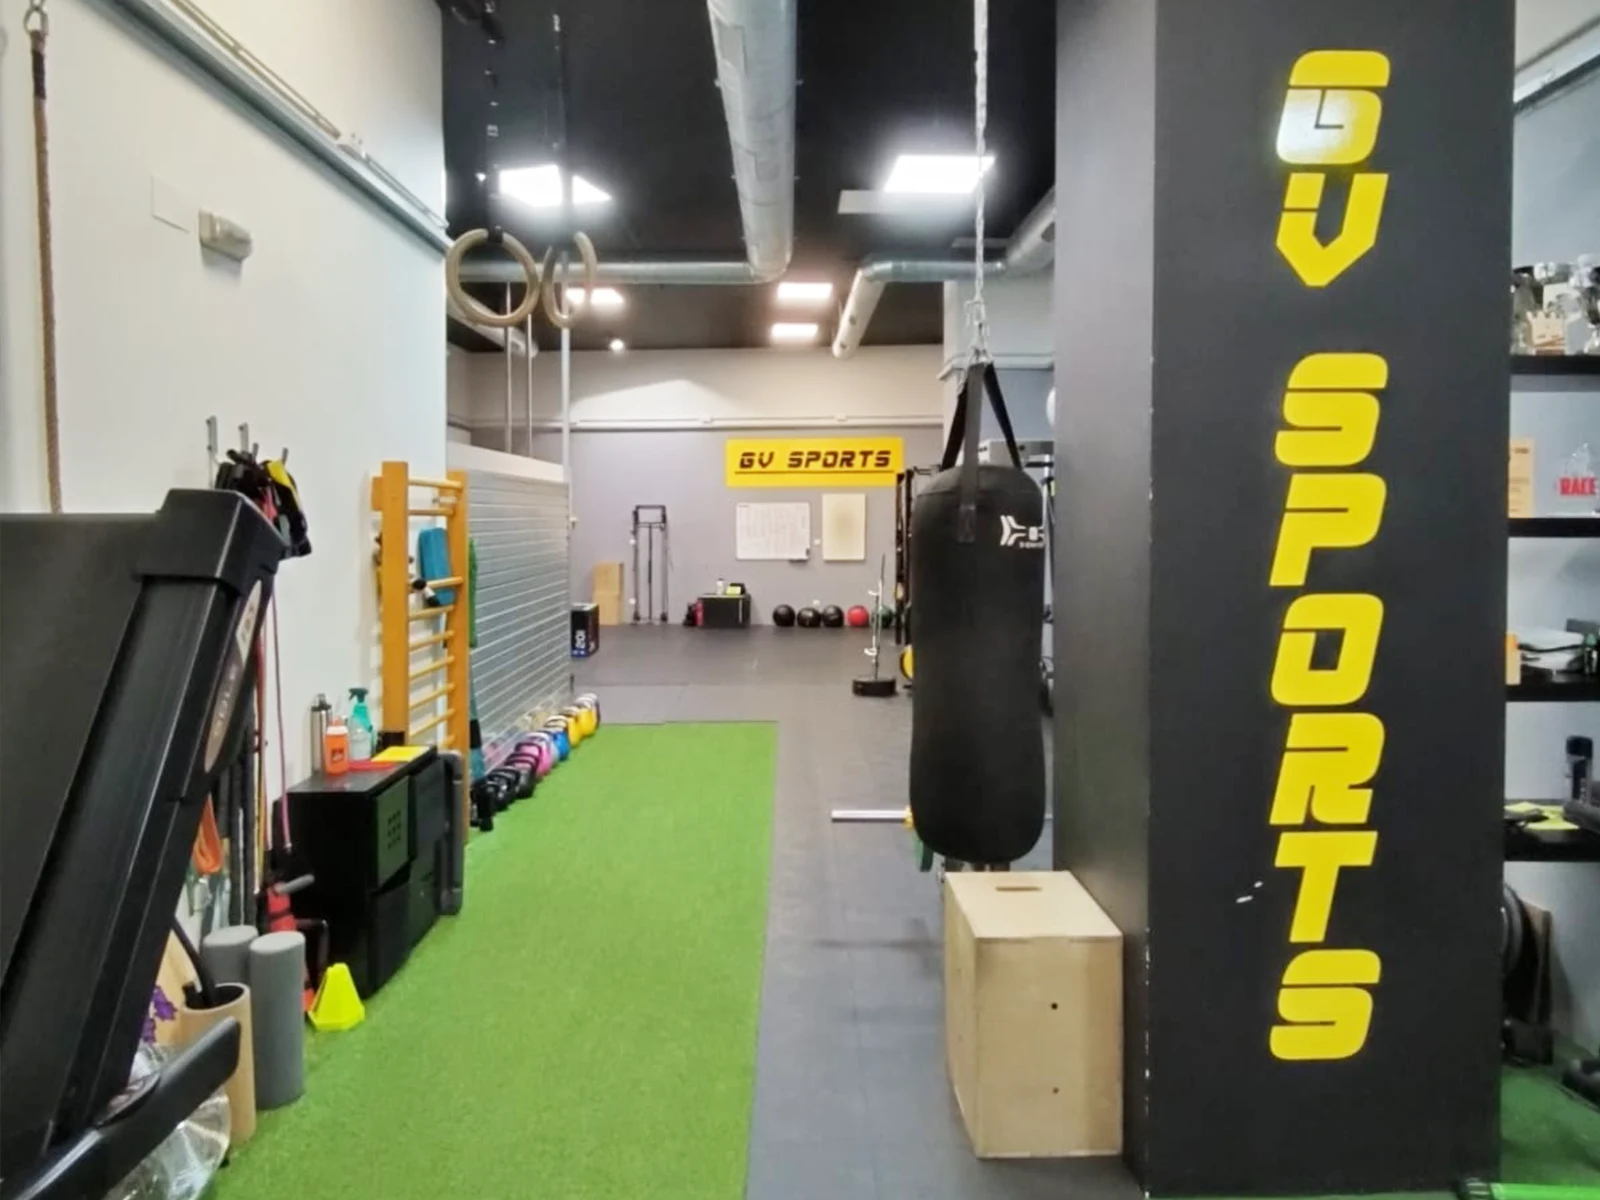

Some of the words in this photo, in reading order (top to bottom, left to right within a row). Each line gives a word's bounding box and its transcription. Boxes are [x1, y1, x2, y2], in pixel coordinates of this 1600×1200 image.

[1275, 49, 1389, 287] GV
[739, 452, 774, 469] GV
[788, 450, 892, 468] SPORTS
[1268, 352, 1388, 1061] SPORTS
